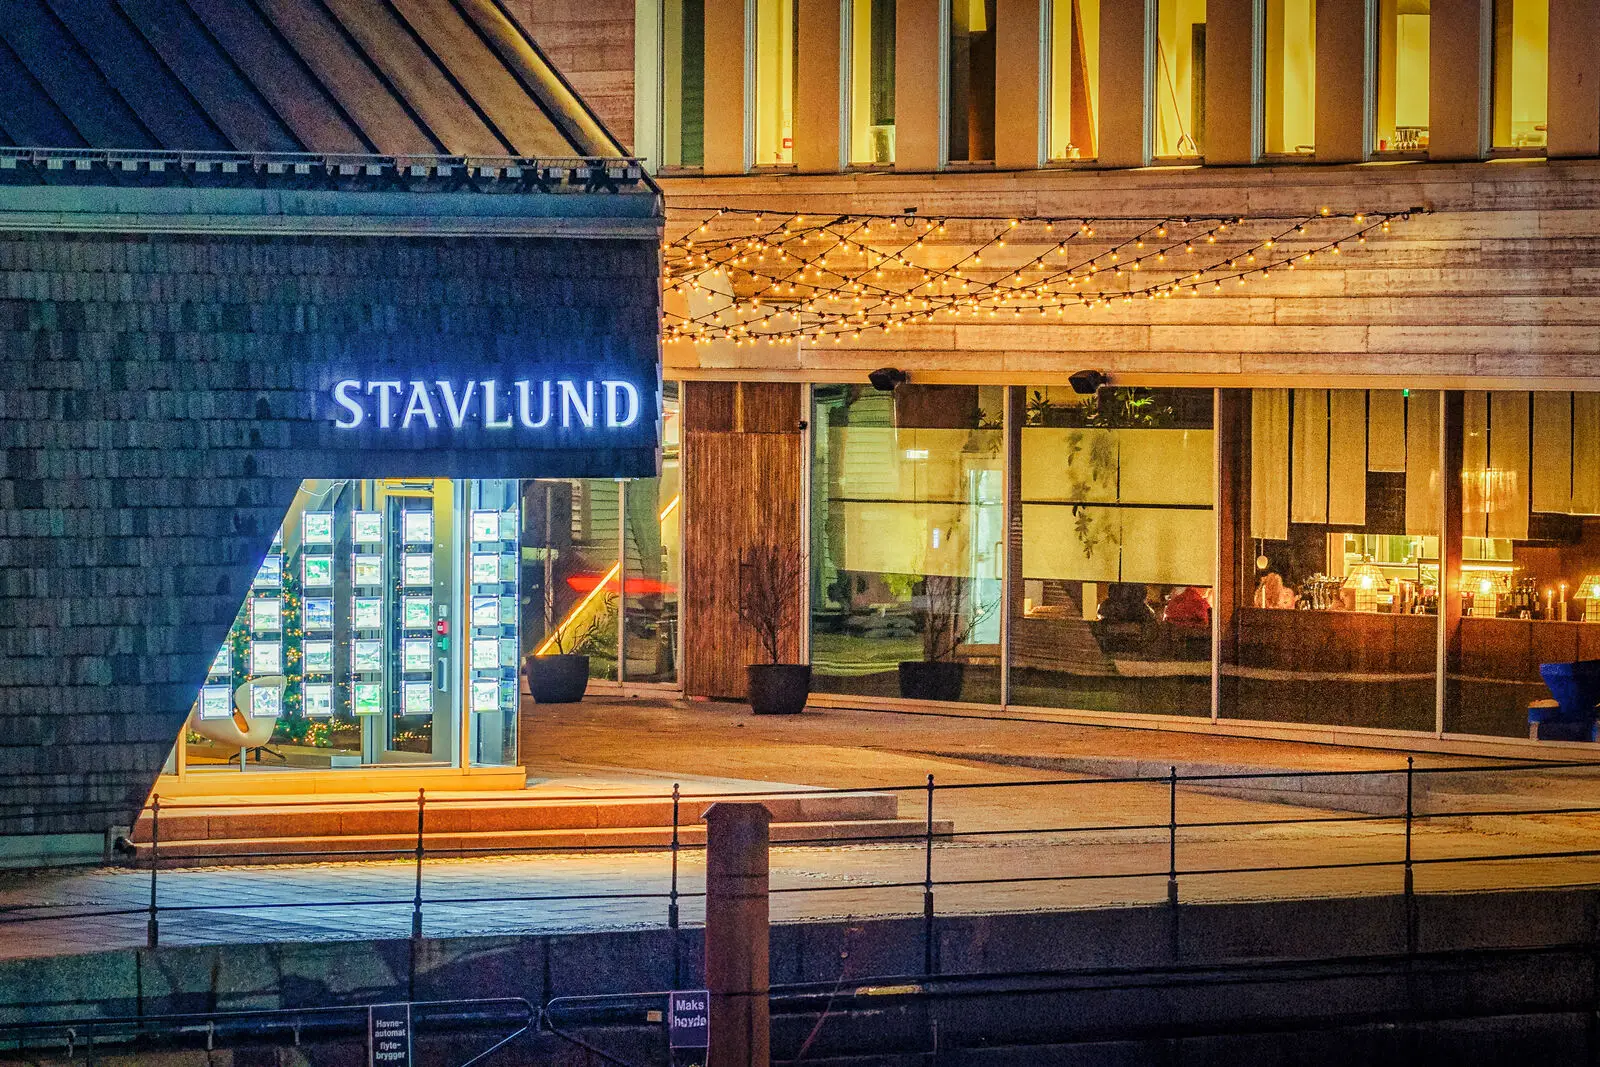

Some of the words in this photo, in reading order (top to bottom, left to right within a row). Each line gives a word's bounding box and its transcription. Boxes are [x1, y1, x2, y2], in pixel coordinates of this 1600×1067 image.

[334, 380, 639, 428] STAVLUND
[676, 1000, 705, 1011] Maks
[374, 1029, 406, 1037] automat
[375, 1051, 406, 1061] brygger
